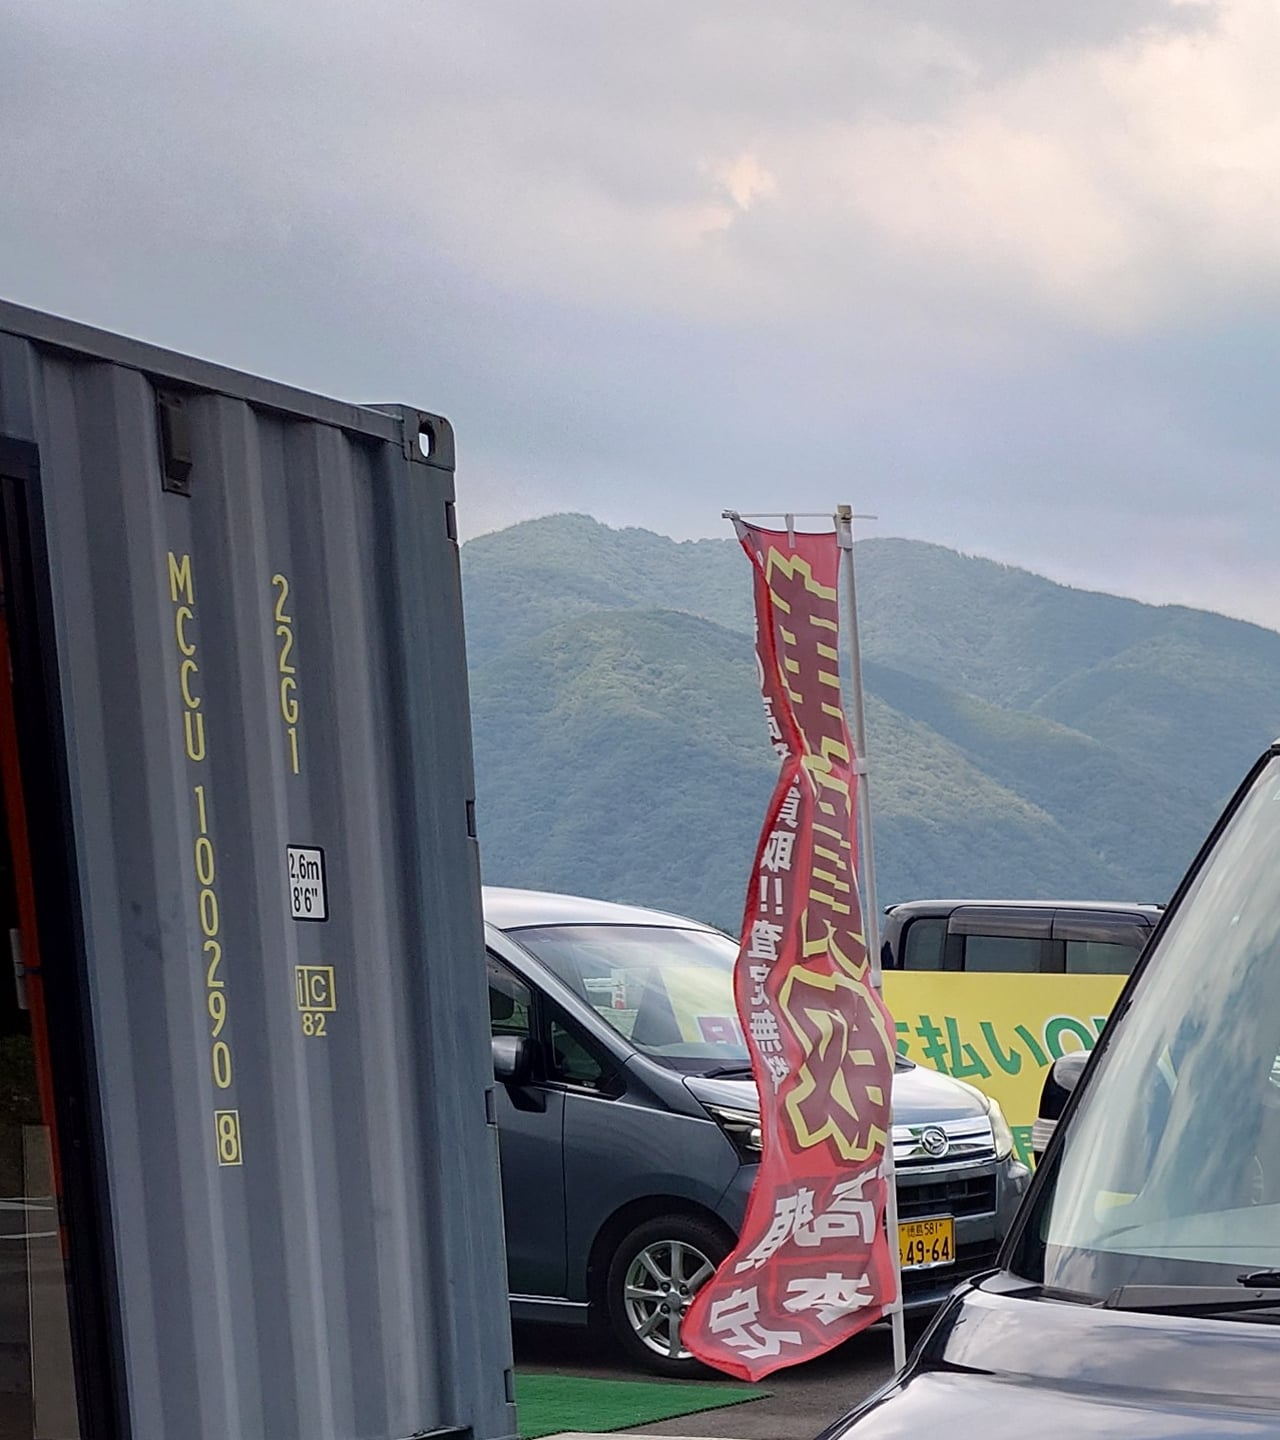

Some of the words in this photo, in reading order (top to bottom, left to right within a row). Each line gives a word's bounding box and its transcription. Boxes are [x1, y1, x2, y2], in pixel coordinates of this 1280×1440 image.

[271, 573, 301, 776] 22G1
[168, 551, 206, 763] MCCU
[193, 786, 234, 1090] 100290
[218, 1115, 238, 1164] 8
[302, 1012, 328, 1037] 82
[895, 1014, 1108, 1080] 払いO
[906, 1235, 950, 1265] 49-64
